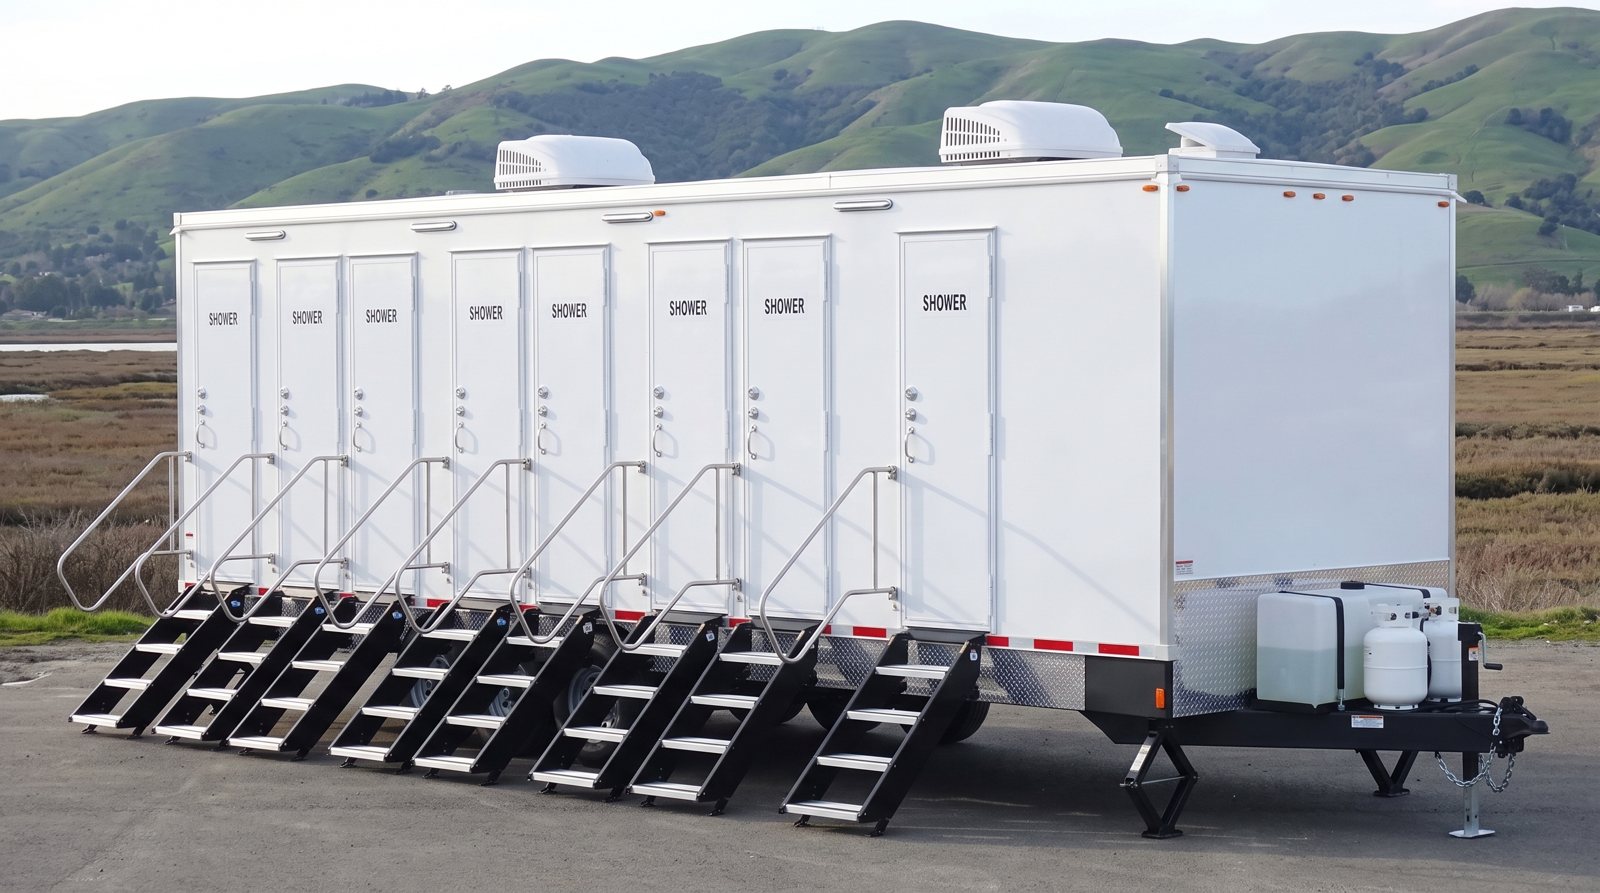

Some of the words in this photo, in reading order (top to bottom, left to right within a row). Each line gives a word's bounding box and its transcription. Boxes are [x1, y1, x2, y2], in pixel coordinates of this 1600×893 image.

[669, 300, 707, 316] SHOWER
[764, 298, 805, 314] SHOWER
[923, 294, 967, 311] SHOWER
[292, 311, 323, 325] SHOWER
[366, 309, 397, 323] SHOWER
[469, 305, 503, 320] SHOWER
[552, 303, 587, 318] SHOWER
[209, 312, 238, 326] SHOWER
